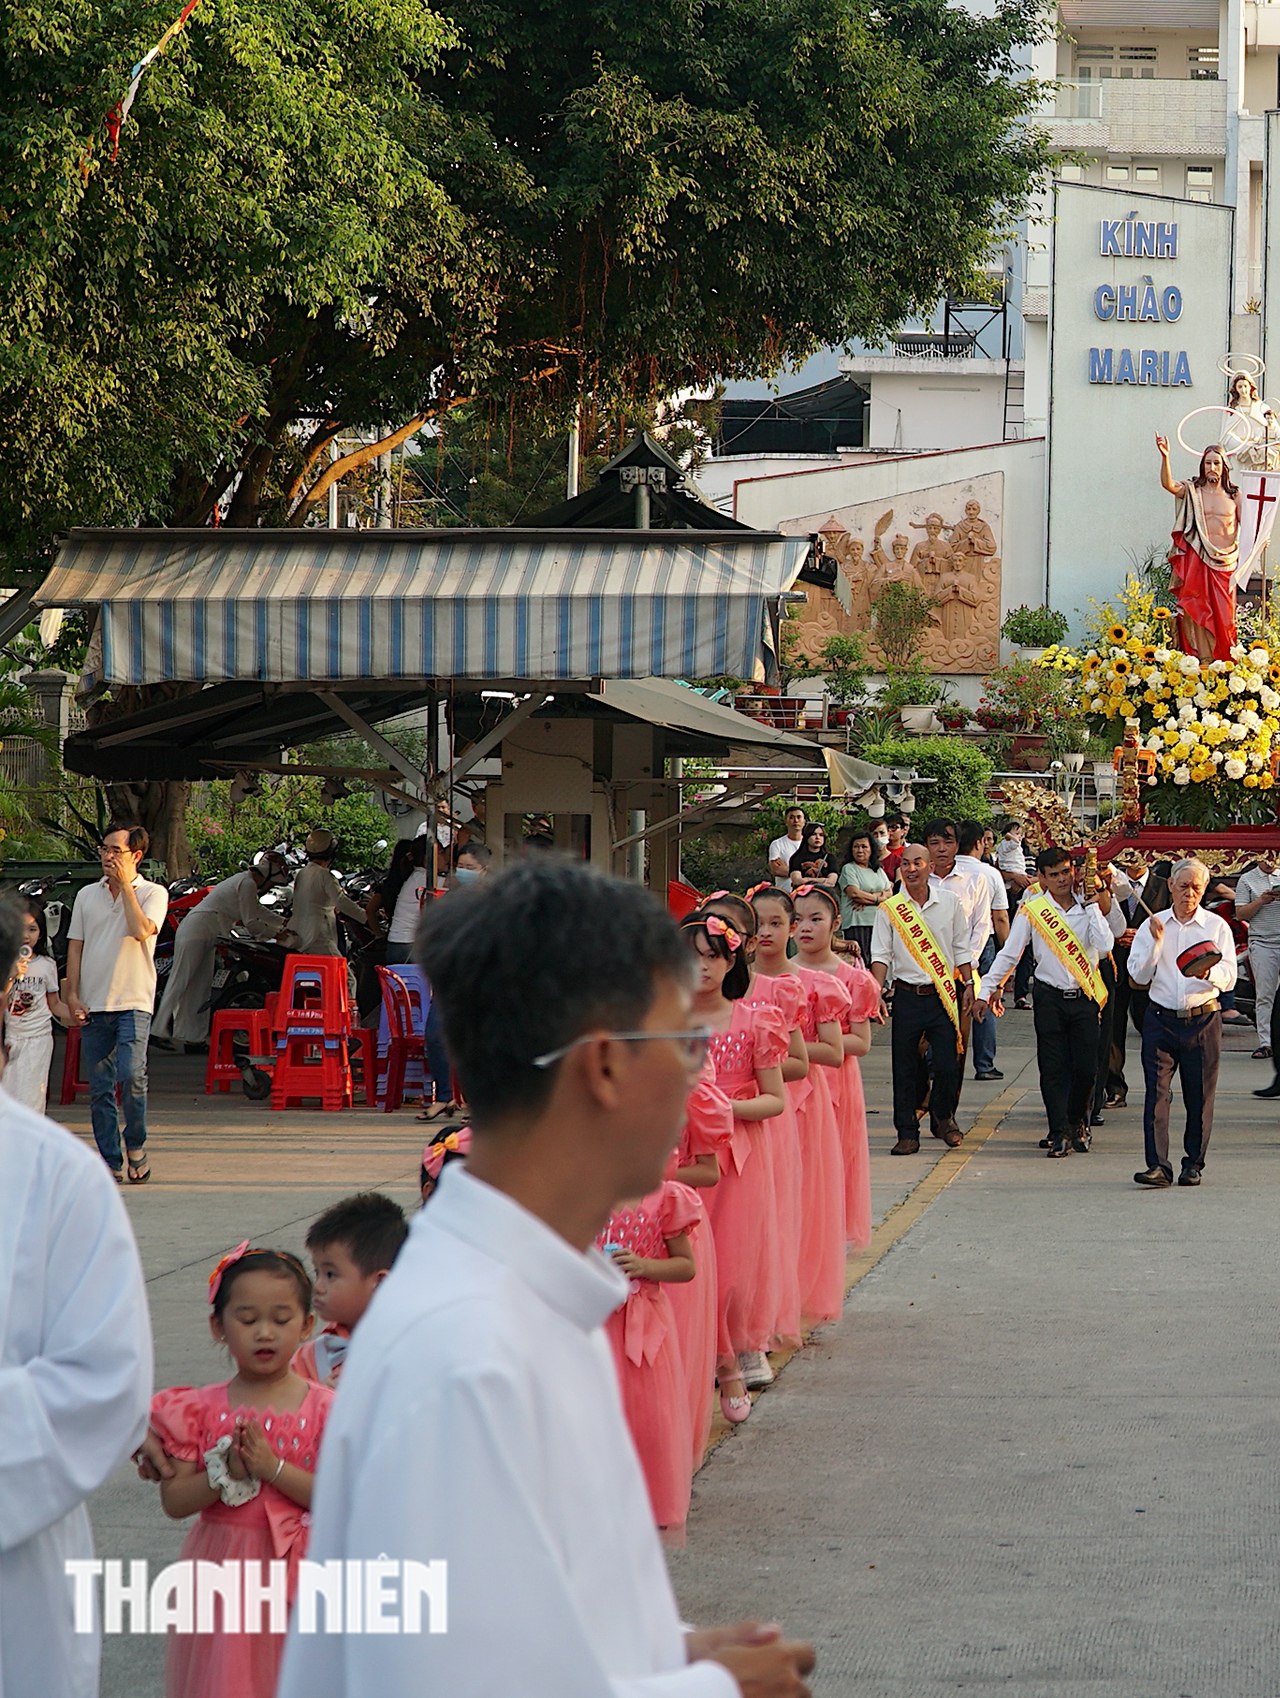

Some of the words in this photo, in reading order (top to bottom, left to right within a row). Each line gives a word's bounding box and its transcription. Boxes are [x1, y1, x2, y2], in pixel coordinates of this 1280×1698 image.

[1100, 210, 1179, 259] KÍNH
[1094, 274, 1184, 323] CHÀO
[1089, 347, 1193, 387] MARIA
[895, 903, 913, 924] GIÁO
[909, 923, 924, 938] HỌ
[918, 937, 932, 953] MẸ
[927, 951, 946, 979] THIÊN
[1040, 908, 1059, 930] GIÁO
[1055, 928, 1069, 943] HỌ
[1065, 940, 1079, 956] MẸ
